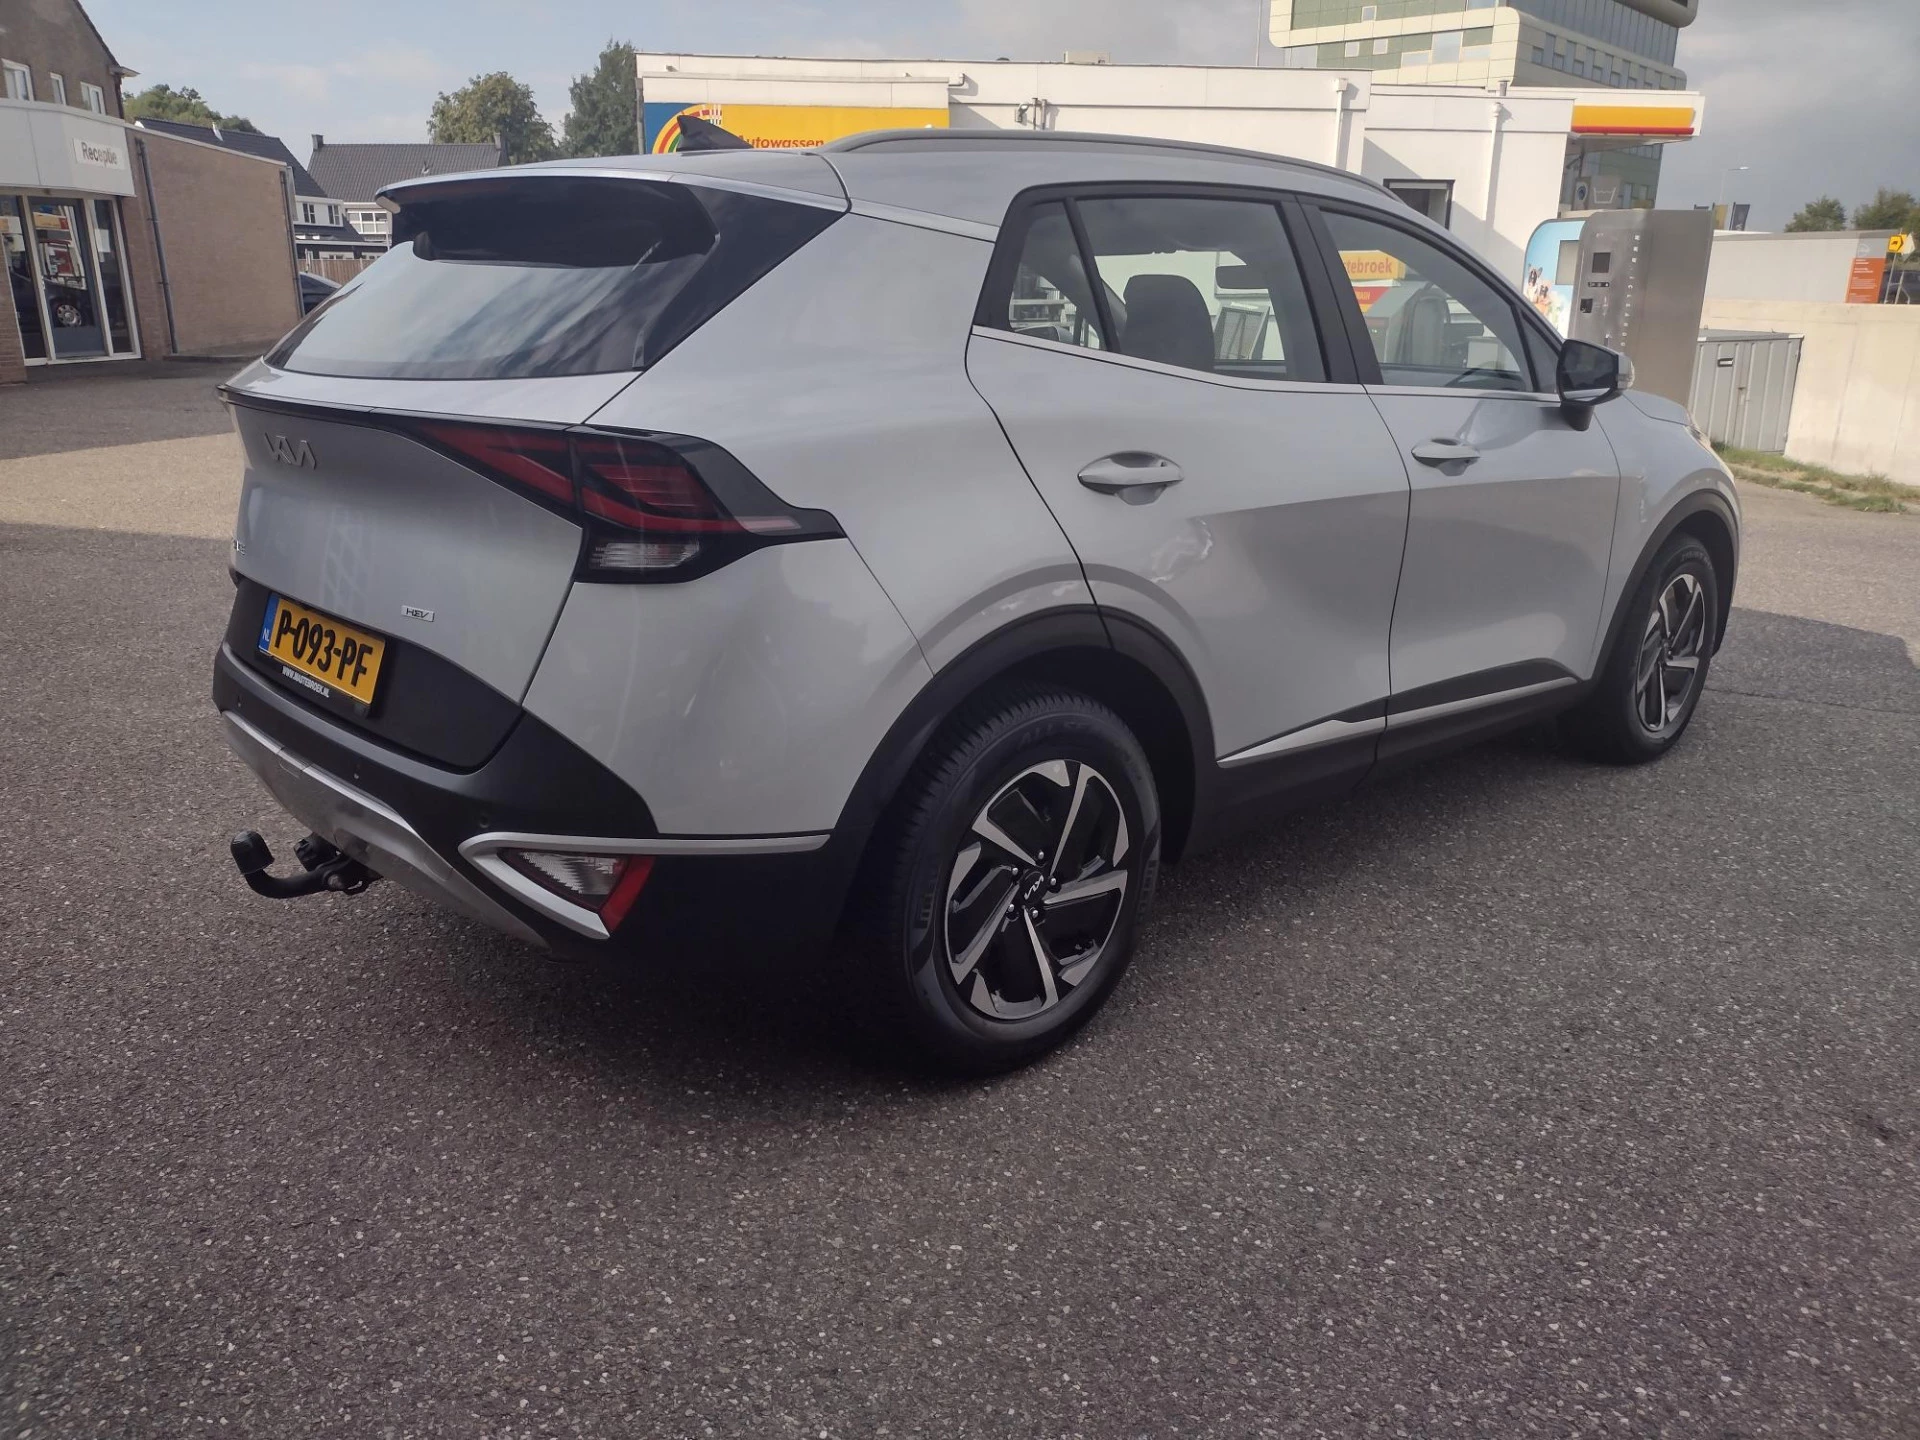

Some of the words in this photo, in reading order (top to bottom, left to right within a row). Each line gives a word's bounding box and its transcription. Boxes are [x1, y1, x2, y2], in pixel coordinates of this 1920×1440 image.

[80, 141, 118, 168] Receptie
[264, 431, 318, 471] KIA
[405, 607, 430, 619] HEV
[262, 627, 270, 642] NL
[274, 609, 374, 688] P-093-PF
